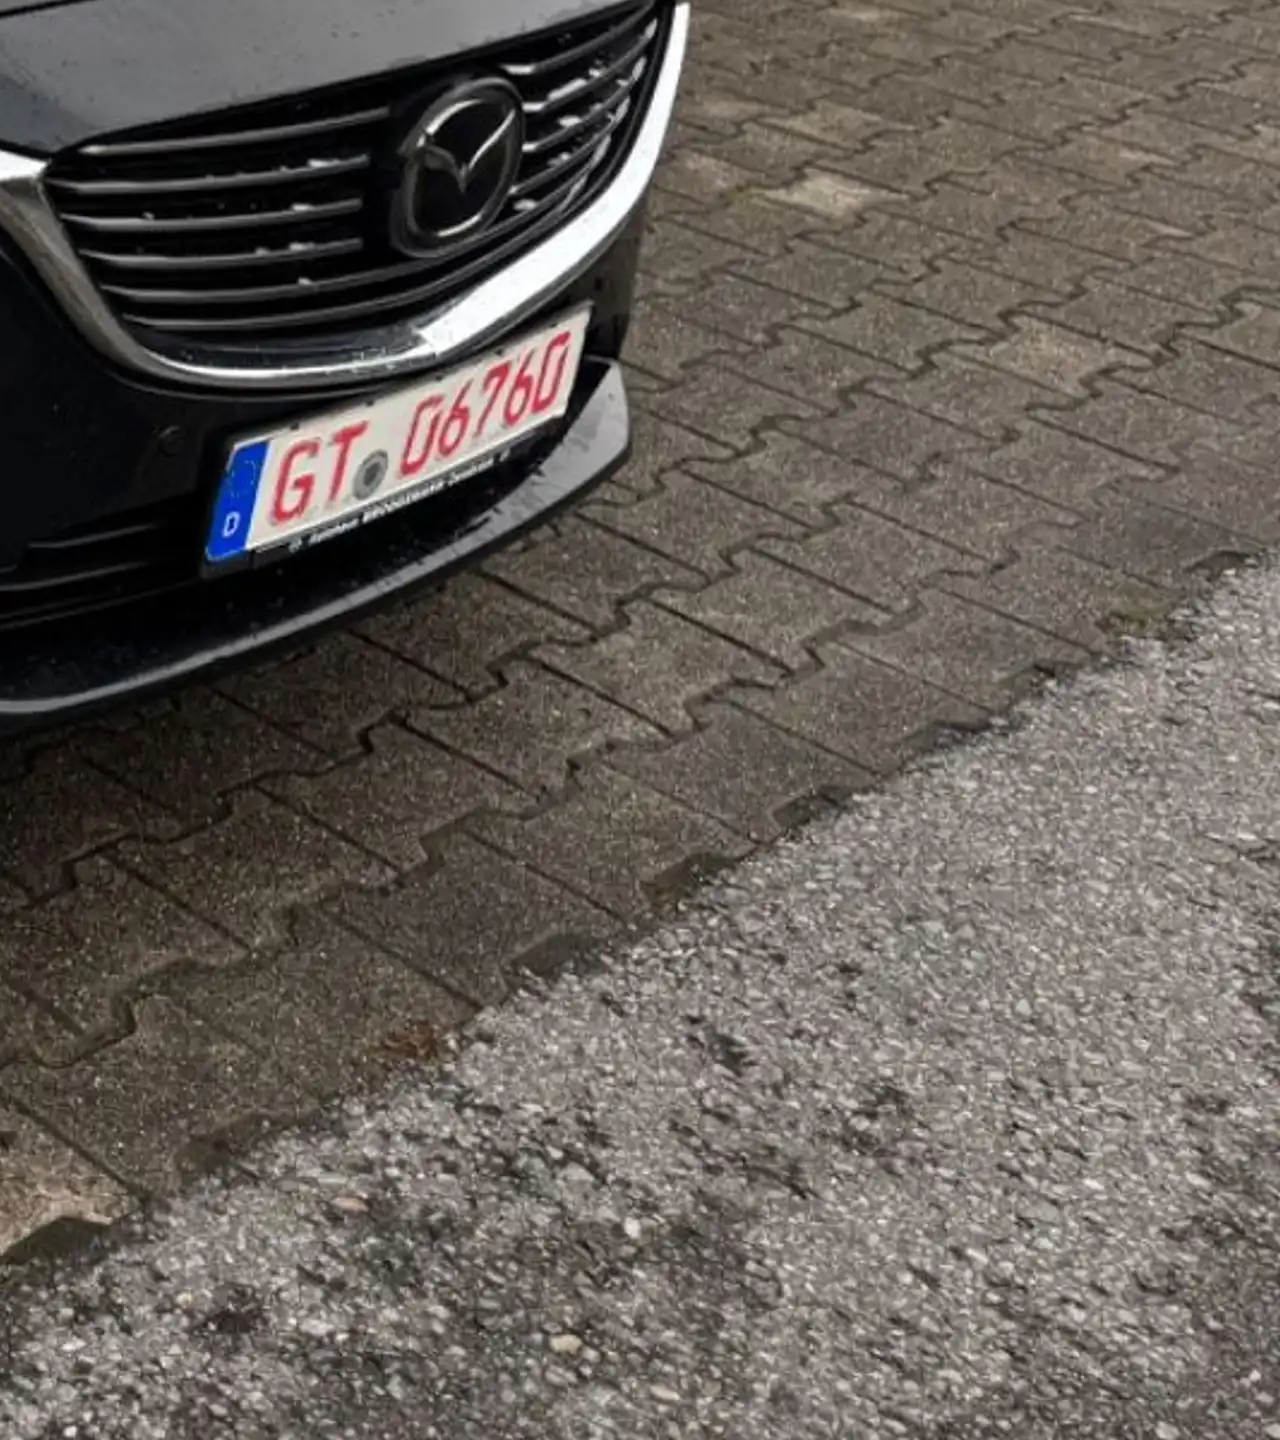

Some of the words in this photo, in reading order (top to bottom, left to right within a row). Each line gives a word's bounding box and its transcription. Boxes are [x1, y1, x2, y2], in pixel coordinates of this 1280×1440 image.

[271, 418, 369, 524] GT
[397, 330, 572, 480] 06760
[223, 511, 240, 537] D
